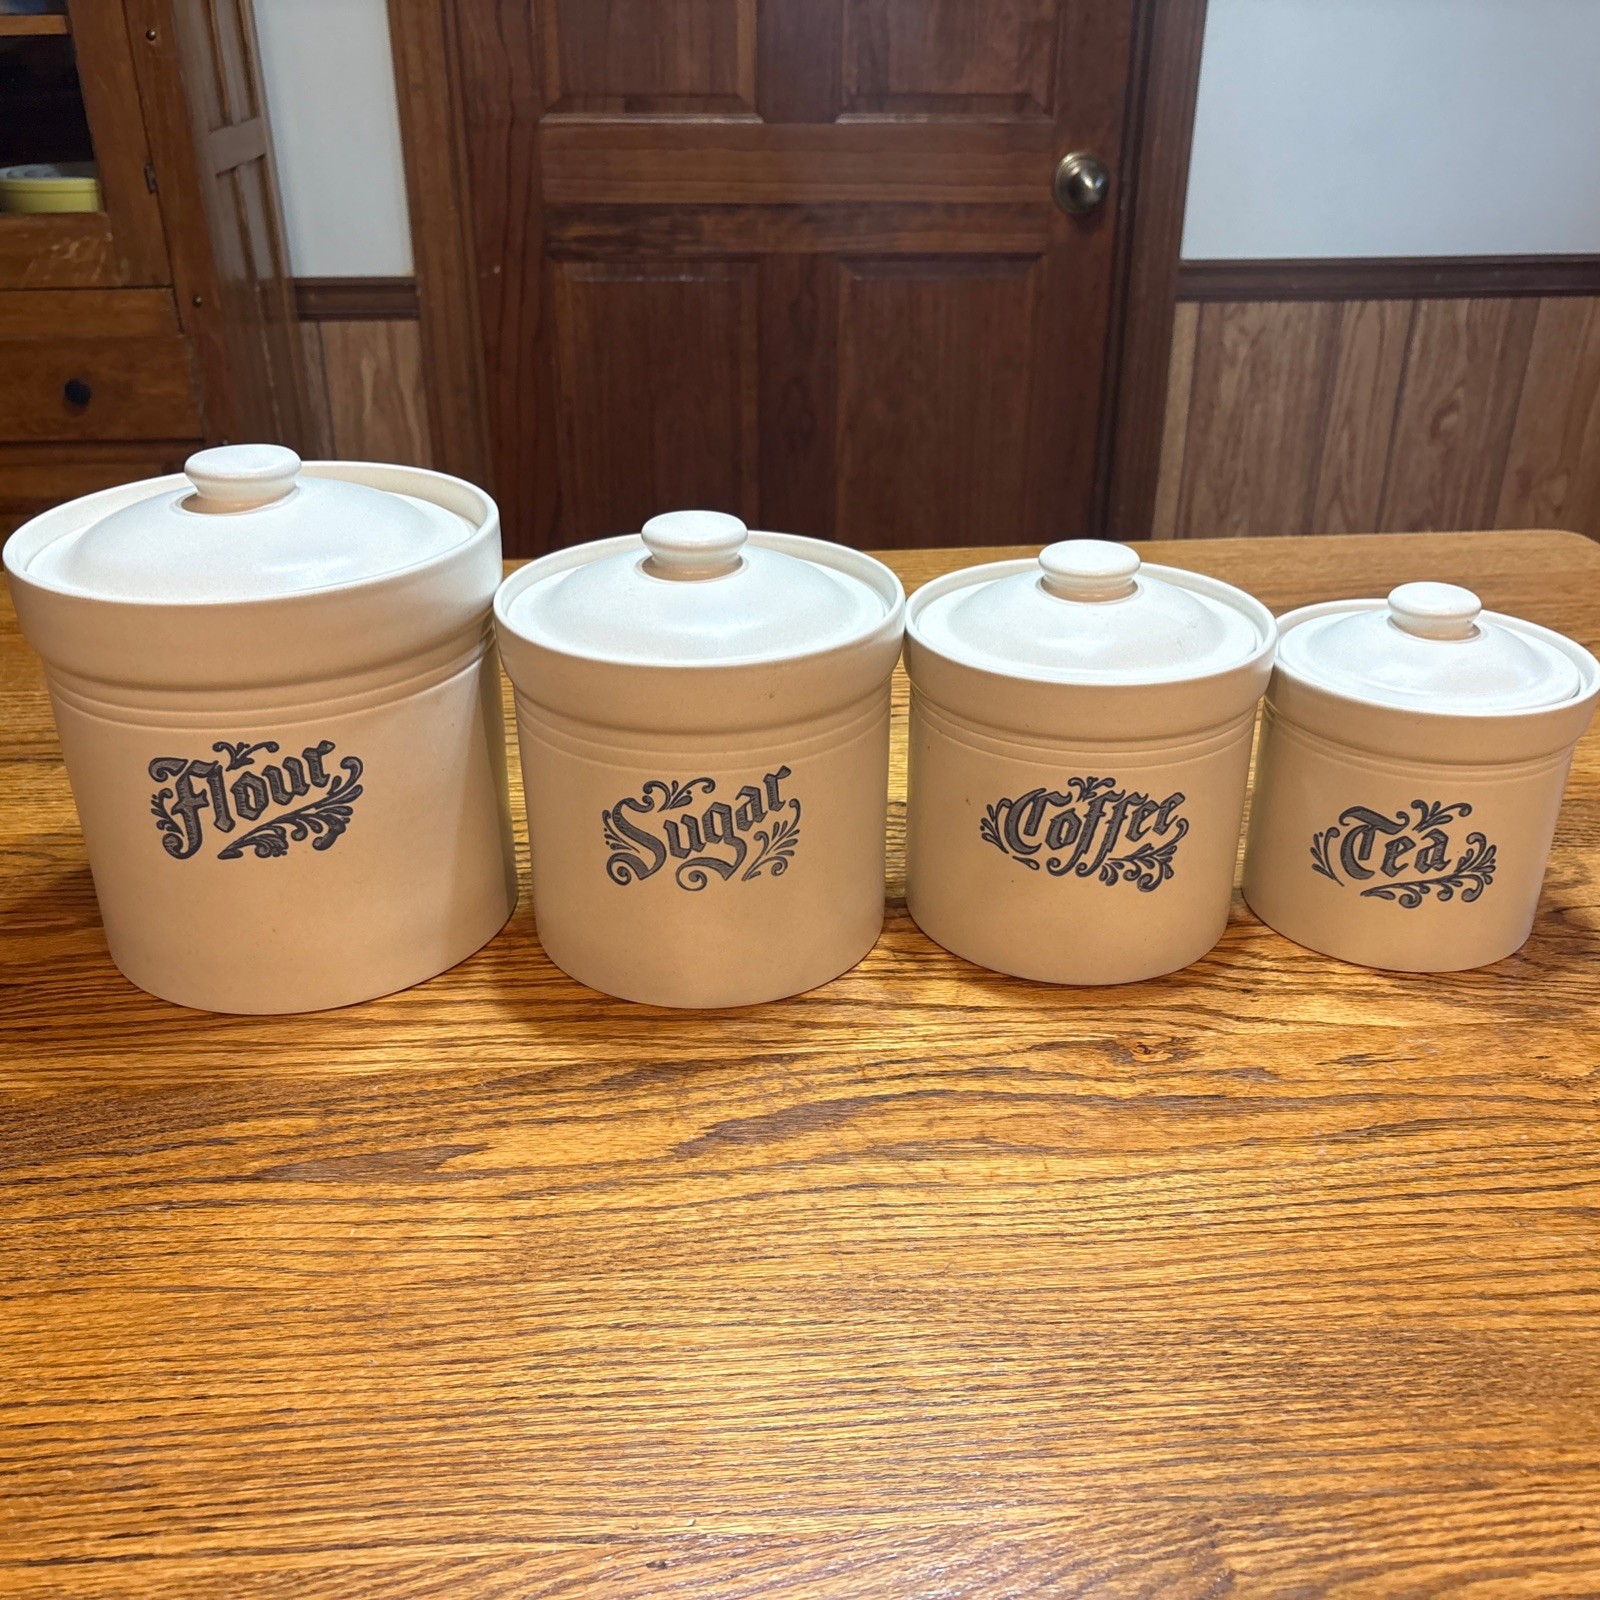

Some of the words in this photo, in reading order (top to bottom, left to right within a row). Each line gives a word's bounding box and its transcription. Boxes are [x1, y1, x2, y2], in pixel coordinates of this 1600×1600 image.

[148, 740, 335, 859] Flour
[606, 765, 791, 891] Sugar
[1004, 788, 1185, 877] Coffee
[1339, 806, 1451, 879] Tea
